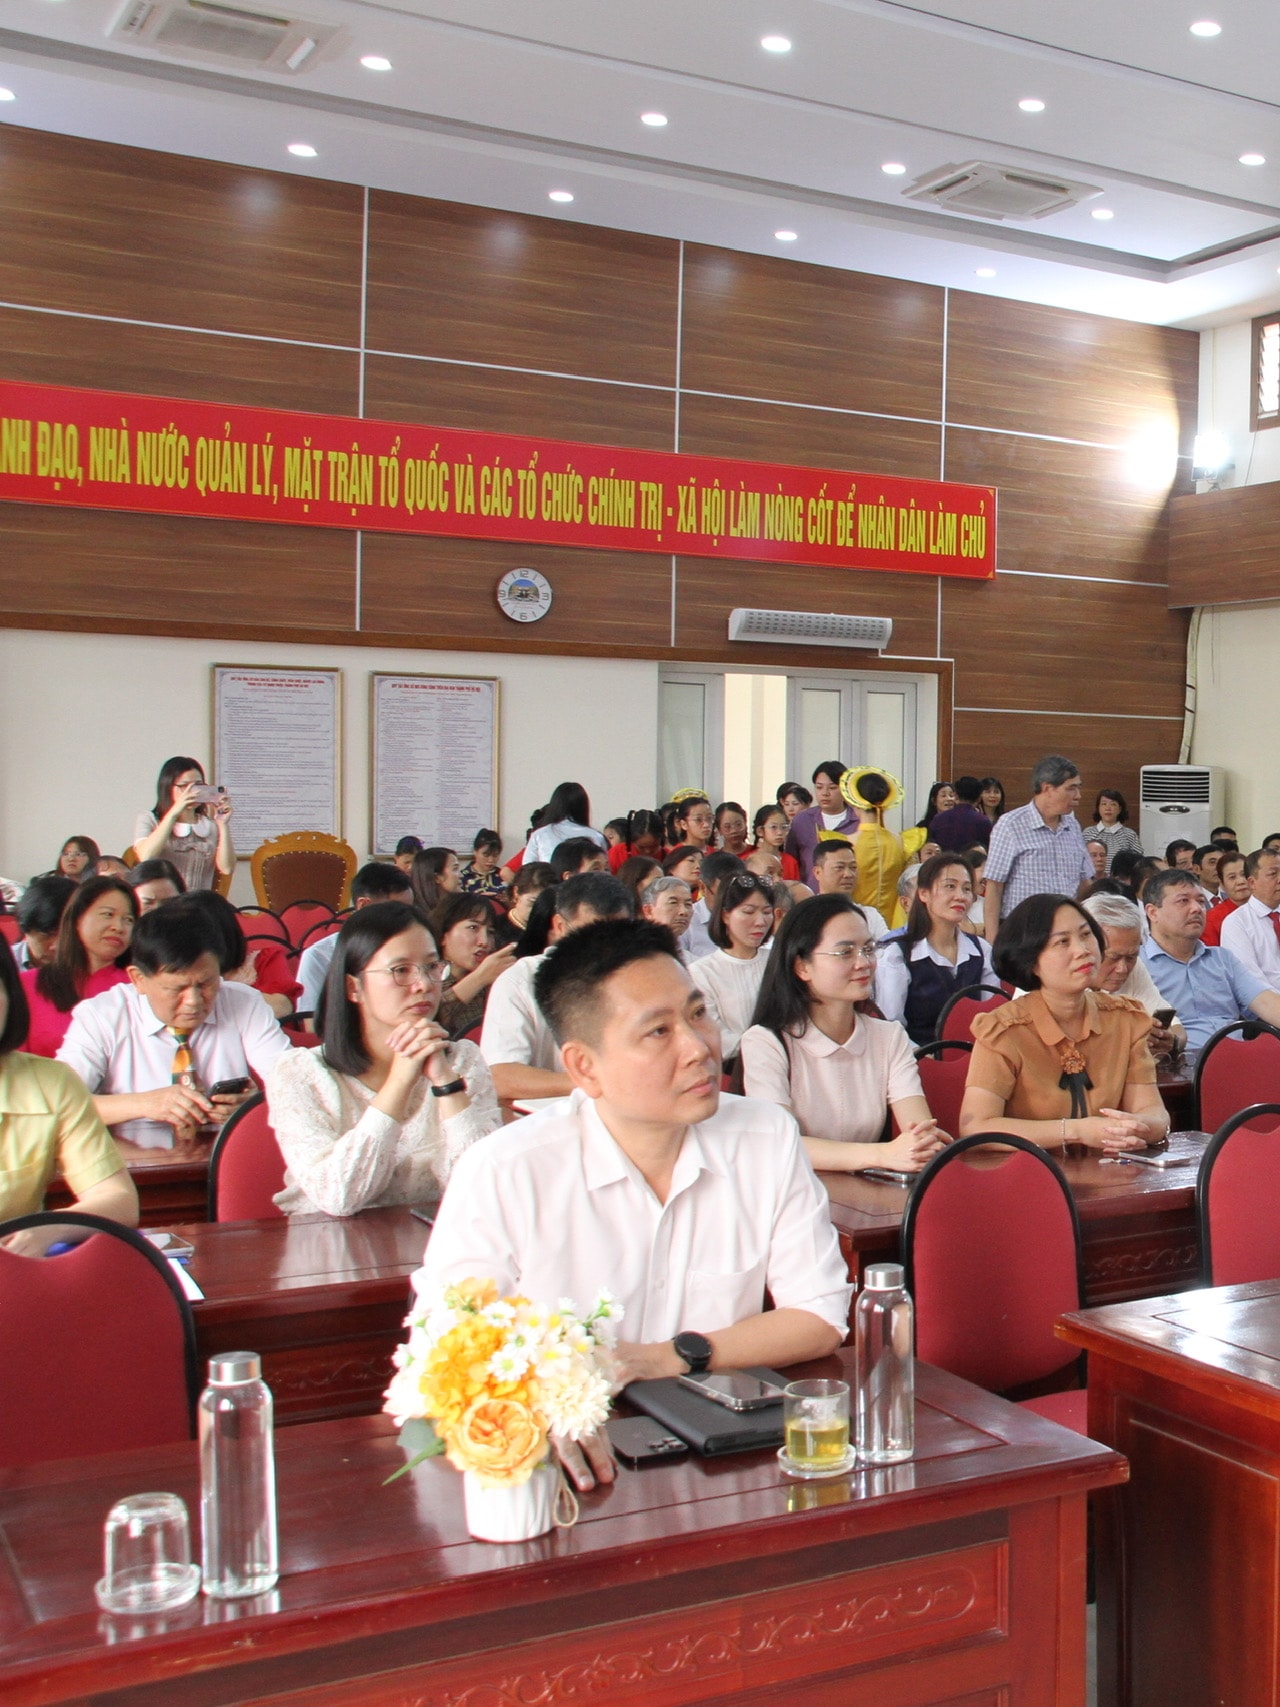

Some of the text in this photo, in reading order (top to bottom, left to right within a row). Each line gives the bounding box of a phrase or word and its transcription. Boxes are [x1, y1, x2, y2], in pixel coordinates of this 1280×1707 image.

[0, 417, 31, 475] NH
[37, 421, 83, 491] ĐẠO,
[89, 418, 131, 484] NHÀ
[137, 422, 190, 489] NƯỚC
[195, 422, 247, 497] QUẢN
[252, 432, 279, 504] LÝ,
[284, 437, 323, 513] MẶT
[328, 442, 374, 516] TRẬN
[379, 436, 401, 508] TỔ
[404, 443, 449, 515] QUỐC
[454, 454, 475, 514] VÀ
[480, 456, 512, 518] CÁC
[518, 451, 539, 520] TỔ
[542, 463, 584, 524] CHỨC
[588, 469, 635, 529] CHÍNH
[640, 481, 663, 541] TRỊ
[677, 477, 697, 534] XÃ
[701, 480, 725, 546] HỘI
[730, 481, 760, 538] LÀM
[765, 483, 804, 543] NÒNG
[808, 483, 834, 545] CỐT
[837, 484, 856, 547] ĐỂ
[858, 495, 896, 550] NHÂN
[899, 498, 926, 553] DÂN
[930, 501, 957, 556] LÀM
[961, 501, 986, 559] CHỦ
